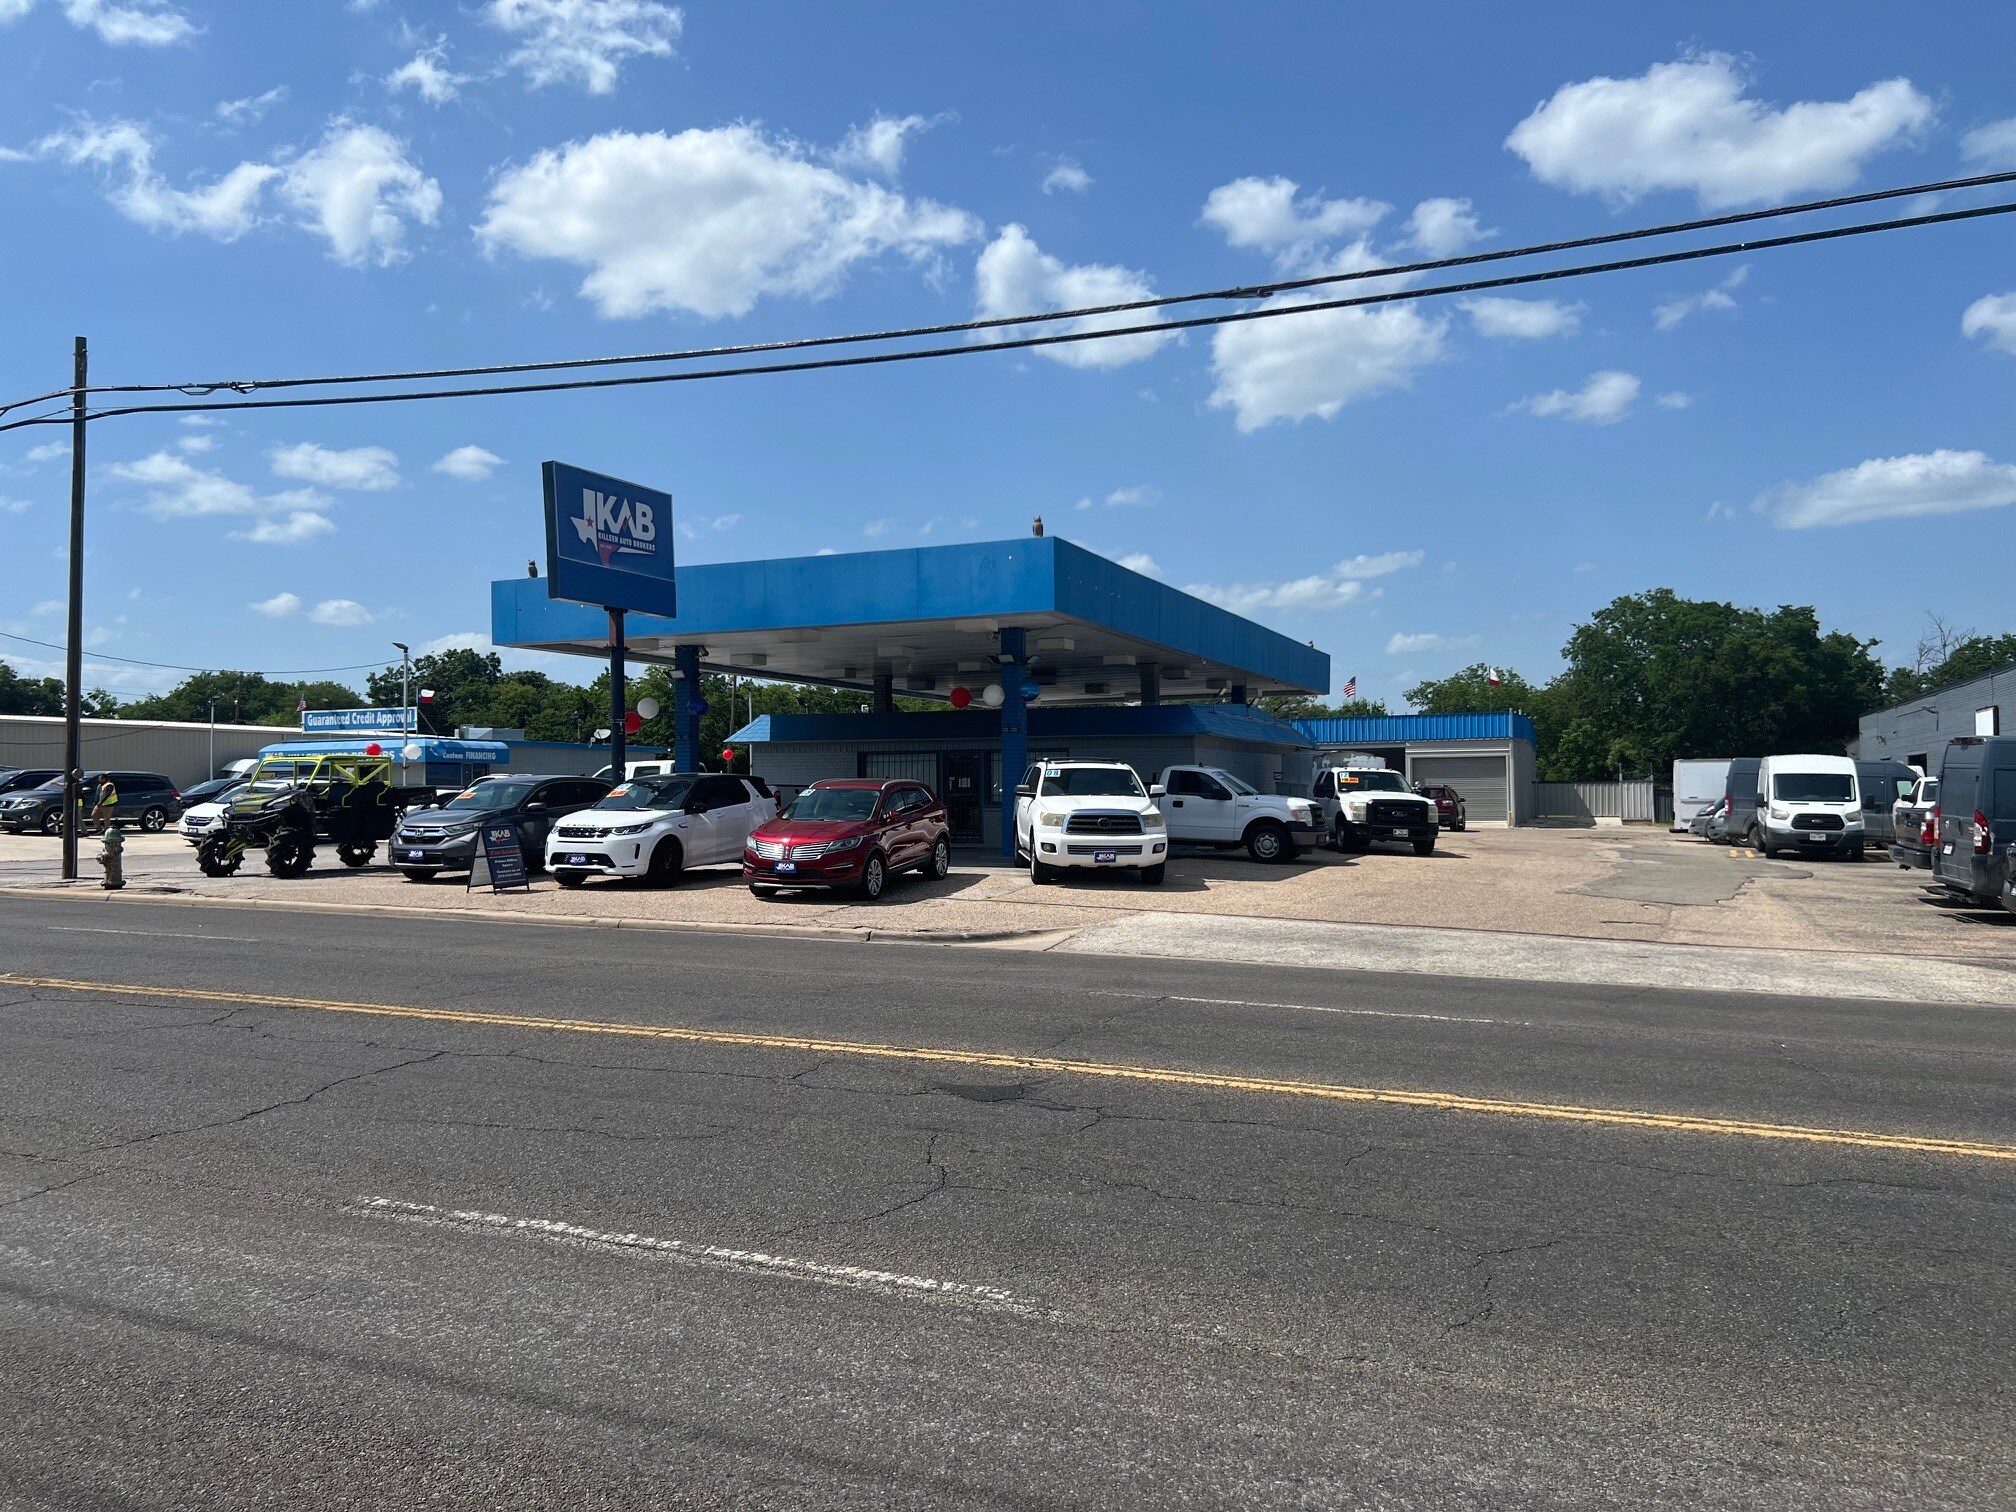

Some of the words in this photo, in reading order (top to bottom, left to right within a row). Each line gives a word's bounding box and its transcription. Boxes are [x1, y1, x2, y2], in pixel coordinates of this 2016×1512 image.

[596, 491, 656, 542] KAB
[598, 532, 618, 543] KILLEEN
[620, 537, 632, 546] AUTO
[633, 540, 656, 552] BROKERS
[307, 712, 350, 726] Guaranteed
[352, 712, 375, 724] Credit
[466, 751, 496, 760] FINANCING
